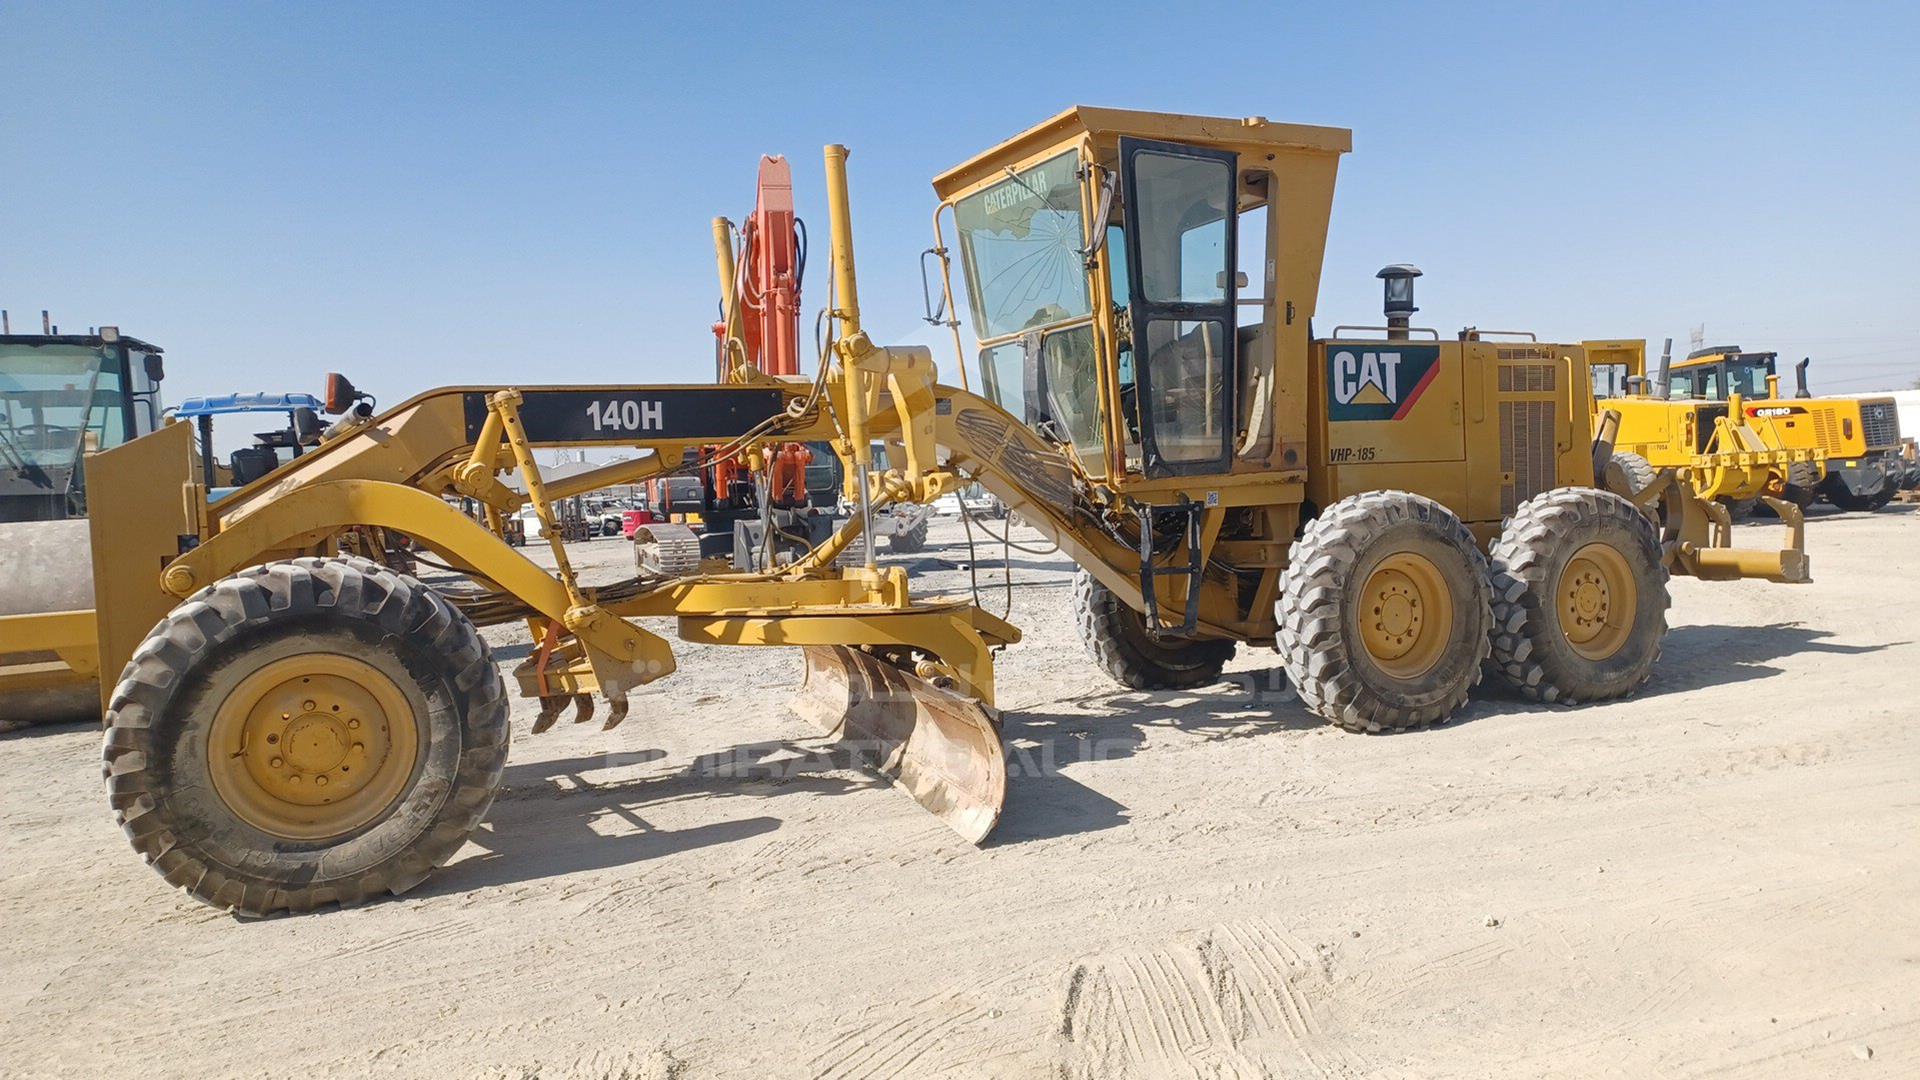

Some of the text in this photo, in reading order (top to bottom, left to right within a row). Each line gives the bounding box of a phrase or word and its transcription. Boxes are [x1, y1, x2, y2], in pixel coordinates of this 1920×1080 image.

[1333, 350, 1402, 405] CAT
[586, 400, 663, 431] 140H
[1329, 447, 1376, 462] VHP-185
